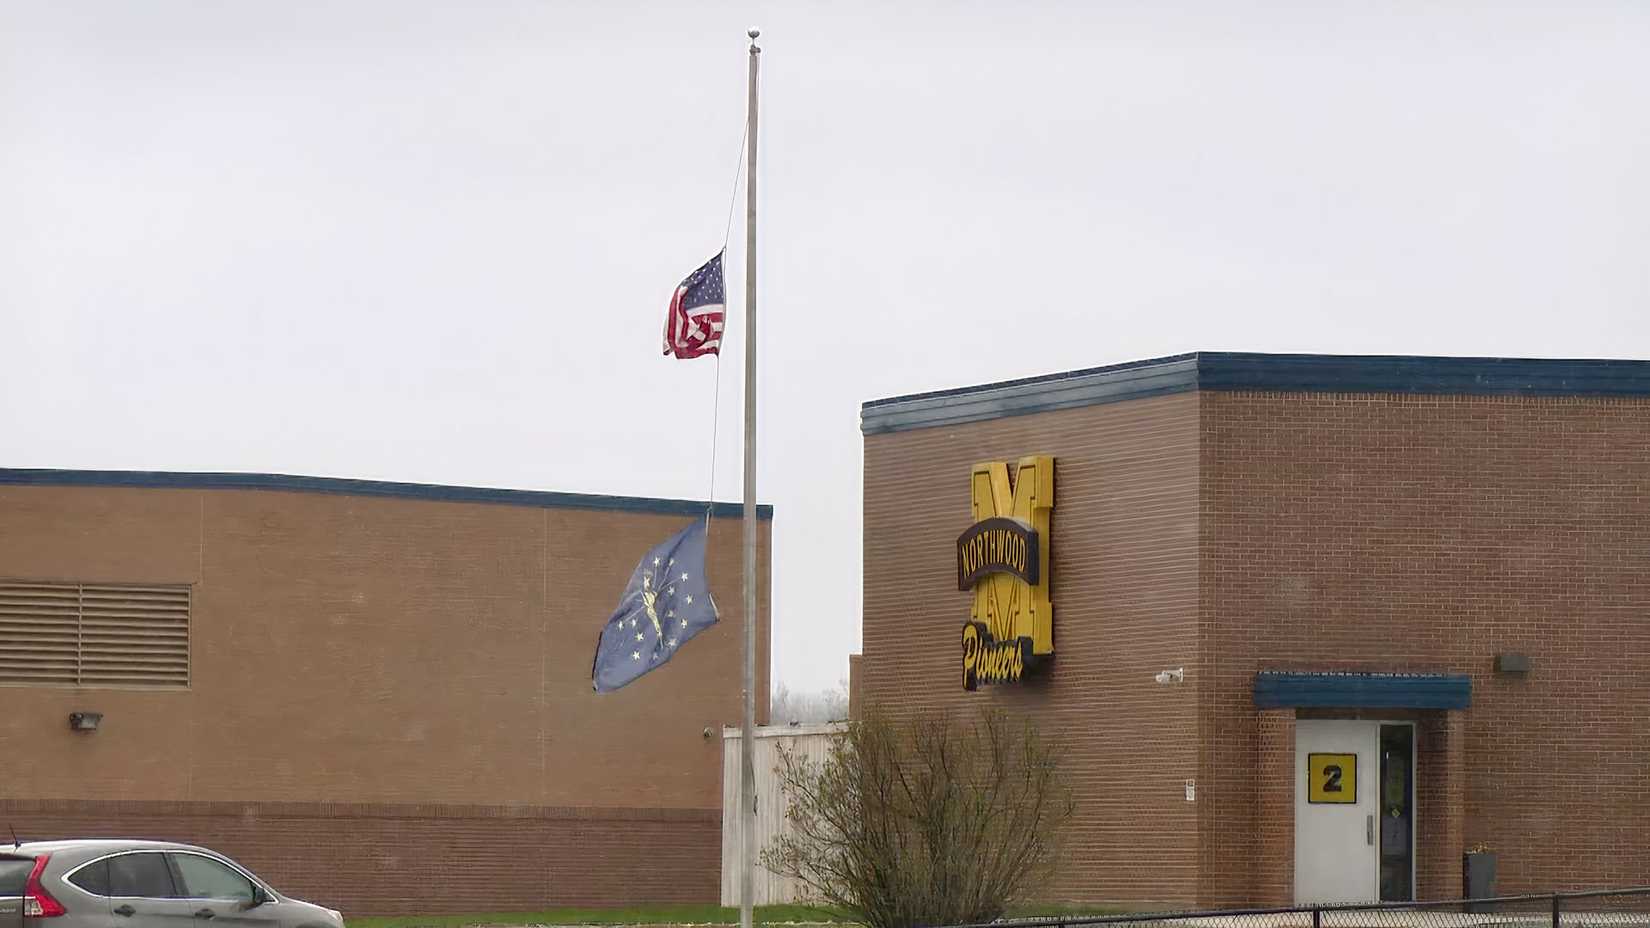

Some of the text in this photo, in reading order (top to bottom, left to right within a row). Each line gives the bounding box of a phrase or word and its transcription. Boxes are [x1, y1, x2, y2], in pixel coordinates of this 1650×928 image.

[962, 529, 1026, 579] NORTHWOOD
[962, 623, 1023, 689] Pioneers
[1322, 765, 1342, 792] 2
